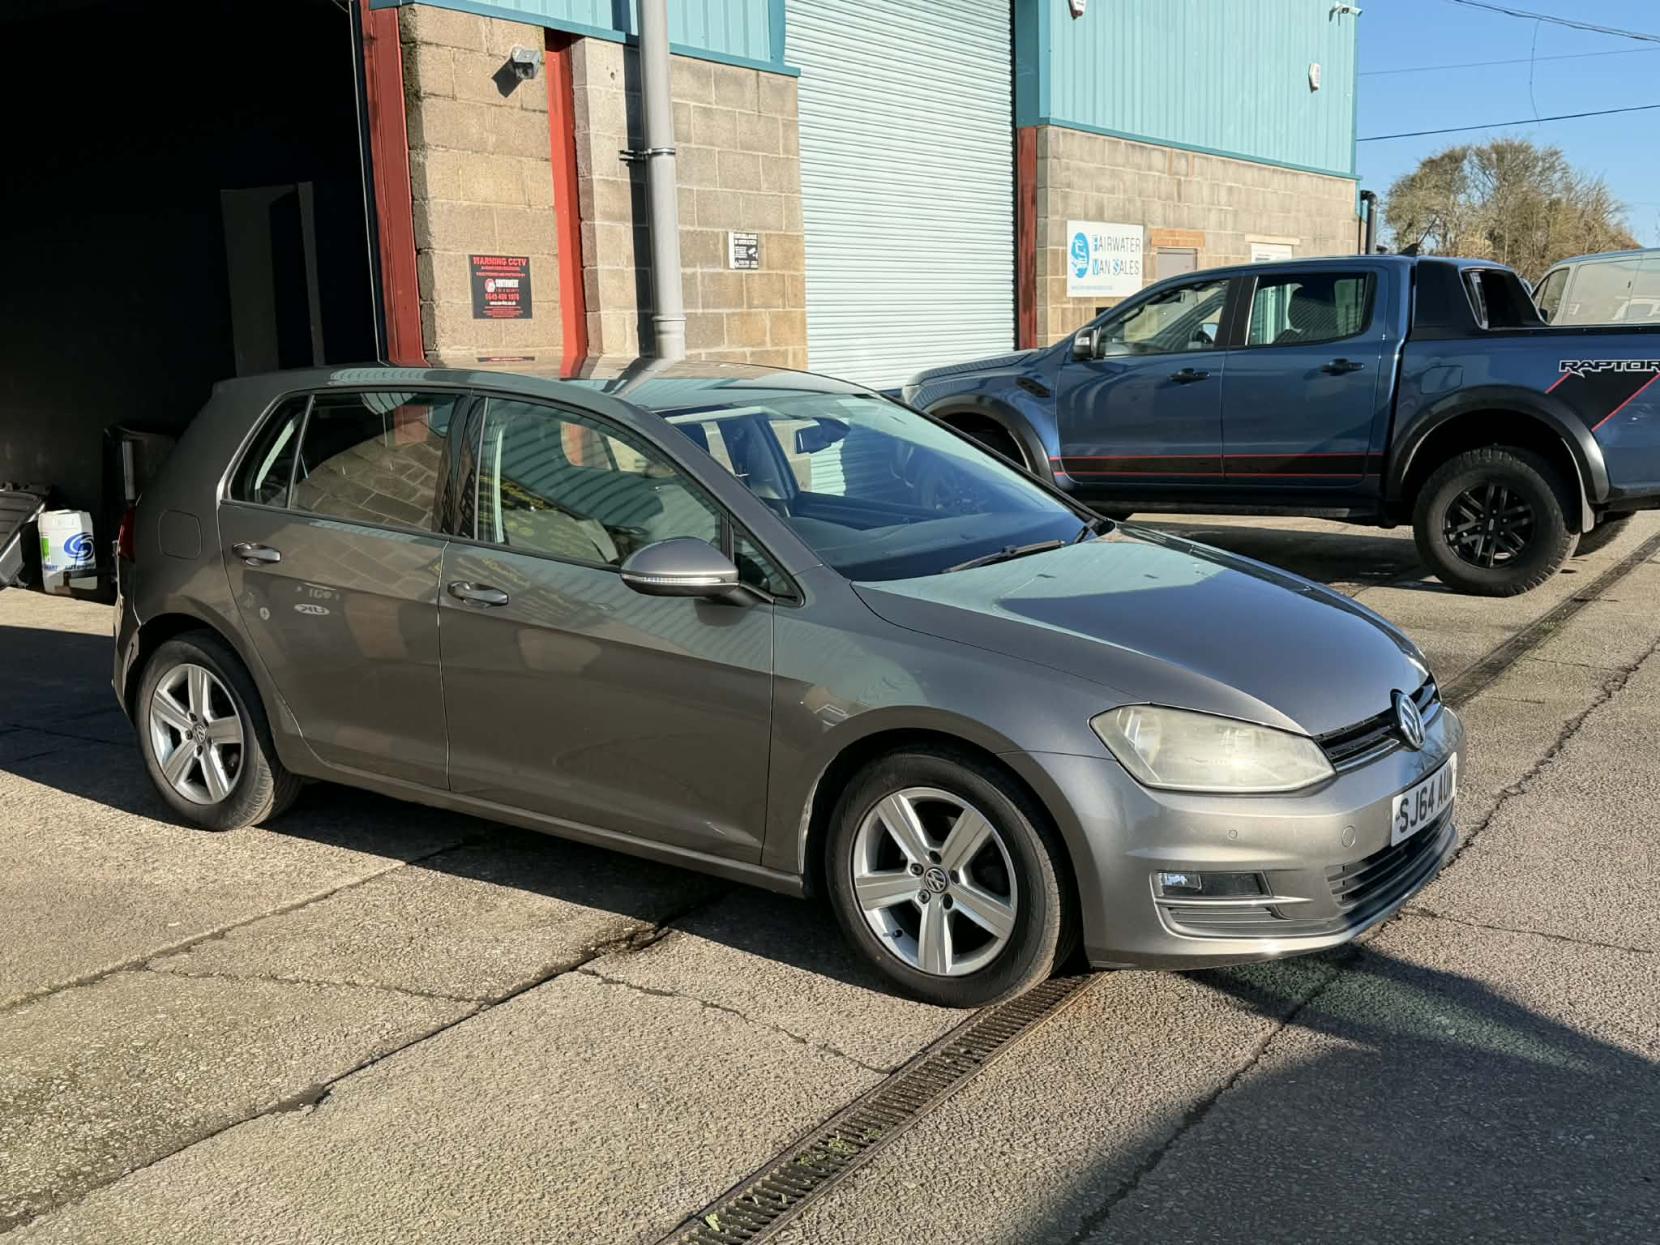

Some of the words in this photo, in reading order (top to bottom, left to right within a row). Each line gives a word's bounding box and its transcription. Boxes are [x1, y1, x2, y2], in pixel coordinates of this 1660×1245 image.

[473, 256, 507, 266] WARNING
[508, 258, 528, 266] CCTV
[1113, 258, 1139, 276] SALES
[1559, 359, 1660, 378] RAPTOR
[1399, 779, 1435, 834] SJ64
